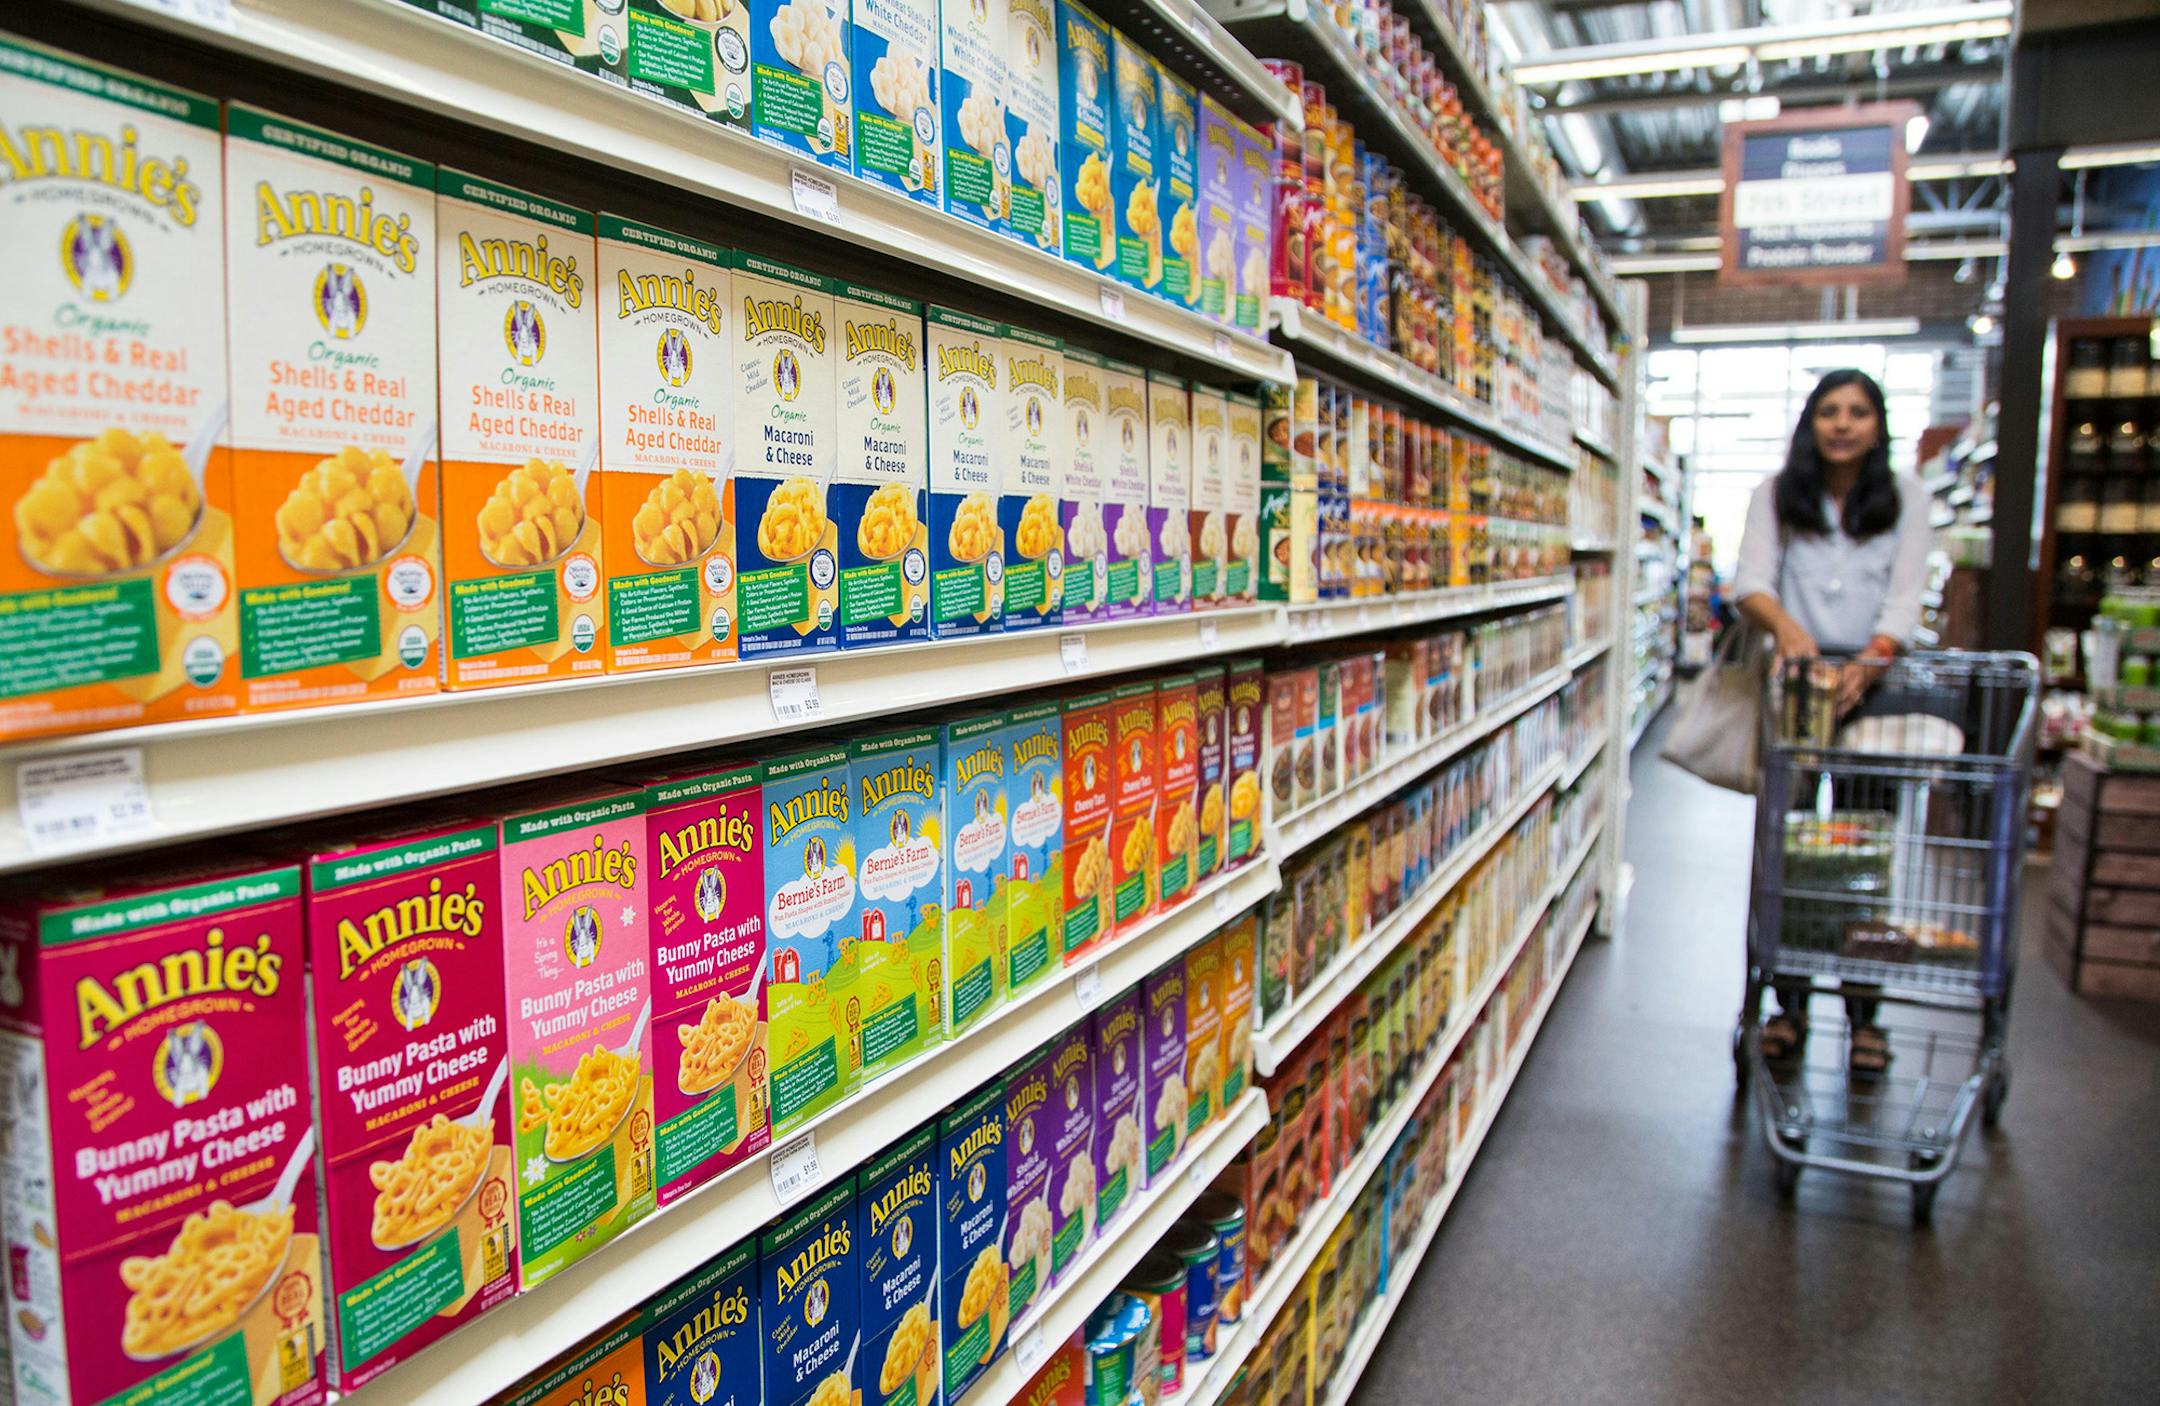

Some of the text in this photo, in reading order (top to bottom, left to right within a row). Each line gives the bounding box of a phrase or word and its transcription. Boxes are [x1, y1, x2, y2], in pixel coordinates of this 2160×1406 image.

[256, 179, 419, 274] Annie's
[530, 203, 576, 226] ORGANIC
[622, 226, 718, 261] CERTIFIED ORGANIC
[458, 231, 584, 310] Annie's
[746, 258, 822, 287] CERTIFIED ORGANIC
[618, 268, 722, 336] Annie's
[847, 286, 912, 310] CERTIFIED ORGANIC
[744, 295, 826, 354] Annie's
[762, 334, 808, 354] HOMEGROWN
[846, 318, 917, 371] Annie's
[269, 359, 406, 398] Shells Real
[501, 367, 555, 392] Organic
[938, 340, 996, 390] Annie's
[265, 391, 416, 428] Aged Cheddar
[471, 384, 576, 417] Shells & Real
[653, 388, 700, 409] Organic
[771, 404, 808, 424] Organic
[468, 412, 583, 443] Aged Cheddar
[628, 404, 716, 432] Shells & Real
[764, 424, 814, 447] Macaroni
[870, 417, 901, 435] Organic
[626, 428, 722, 455] Aged Cheddar
[635, 452, 680, 465] MACARONI
[766, 447, 813, 466] & Cheese
[864, 436, 907, 455] Macaroni
[953, 450, 988, 466] Macaroni
[865, 456, 906, 473] & Cheese
[962, 468, 988, 483] Cheese
[861, 734, 931, 752] Made with Organic Pasta
[1013, 723, 1058, 775] Annie's
[769, 752, 846, 775] Made with Organic Pasta
[956, 738, 1003, 795] Annie's
[658, 774, 753, 801] Made with Organic Pasta
[861, 755, 935, 816] Annie's
[519, 800, 635, 835] Made with Organic Pasta
[770, 776, 849, 847] Annie's
[334, 836, 482, 882] Made with Organic Pasta
[659, 803, 754, 880] Annie's
[867, 846, 929, 875] Bernie's Farm
[522, 833, 637, 923] Annie's
[681, 850, 735, 876] HOMEGROWN
[654, 894, 677, 915] Hooray
[778, 875, 846, 910] Bernie's Farm
[336, 876, 484, 981] Annie's
[657, 915, 761, 967] Bunny Pasta with
[370, 937, 454, 975] HOMEGROWN
[665, 940, 755, 985] Yummy Cheese
[75, 928, 282, 1050] Annie's
[520, 958, 645, 1021] Bunny Pasta with
[676, 964, 751, 999] MACARONI CHEESE
[530, 985, 638, 1041] Yummy Cheese
[337, 1014, 497, 1092] Bunny Pasta with
[350, 1046, 488, 1115] Yummy Cheese
[76, 1084, 297, 1180] Bunny Pasta with
[950, 1114, 1002, 1181] Annie's
[94, 1121, 286, 1206] Yummy Cheese
[774, 1190, 849, 1245] Made with Organic Pasta
[870, 1162, 932, 1237] Annie's
[960, 1201, 994, 1237] Macaroni
[969, 1218, 994, 1245] Cheese
[776, 1219, 851, 1305] Annie's
[883, 1255, 920, 1296] Macaroni
[654, 1251, 747, 1317] Made with Organic Pasta
[885, 1273, 921, 1310] & Cheese
[656, 1284, 749, 1384] Annie's
[771, 1314, 792, 1340] Classic
[775, 1325, 799, 1354] Cheddar
[793, 1320, 840, 1368] Macaroni
[544, 1331, 629, 1389] with Organic Pasta
[677, 1330, 729, 1373] HOMEGROWN
[796, 1339, 840, 1383] & Cheese
